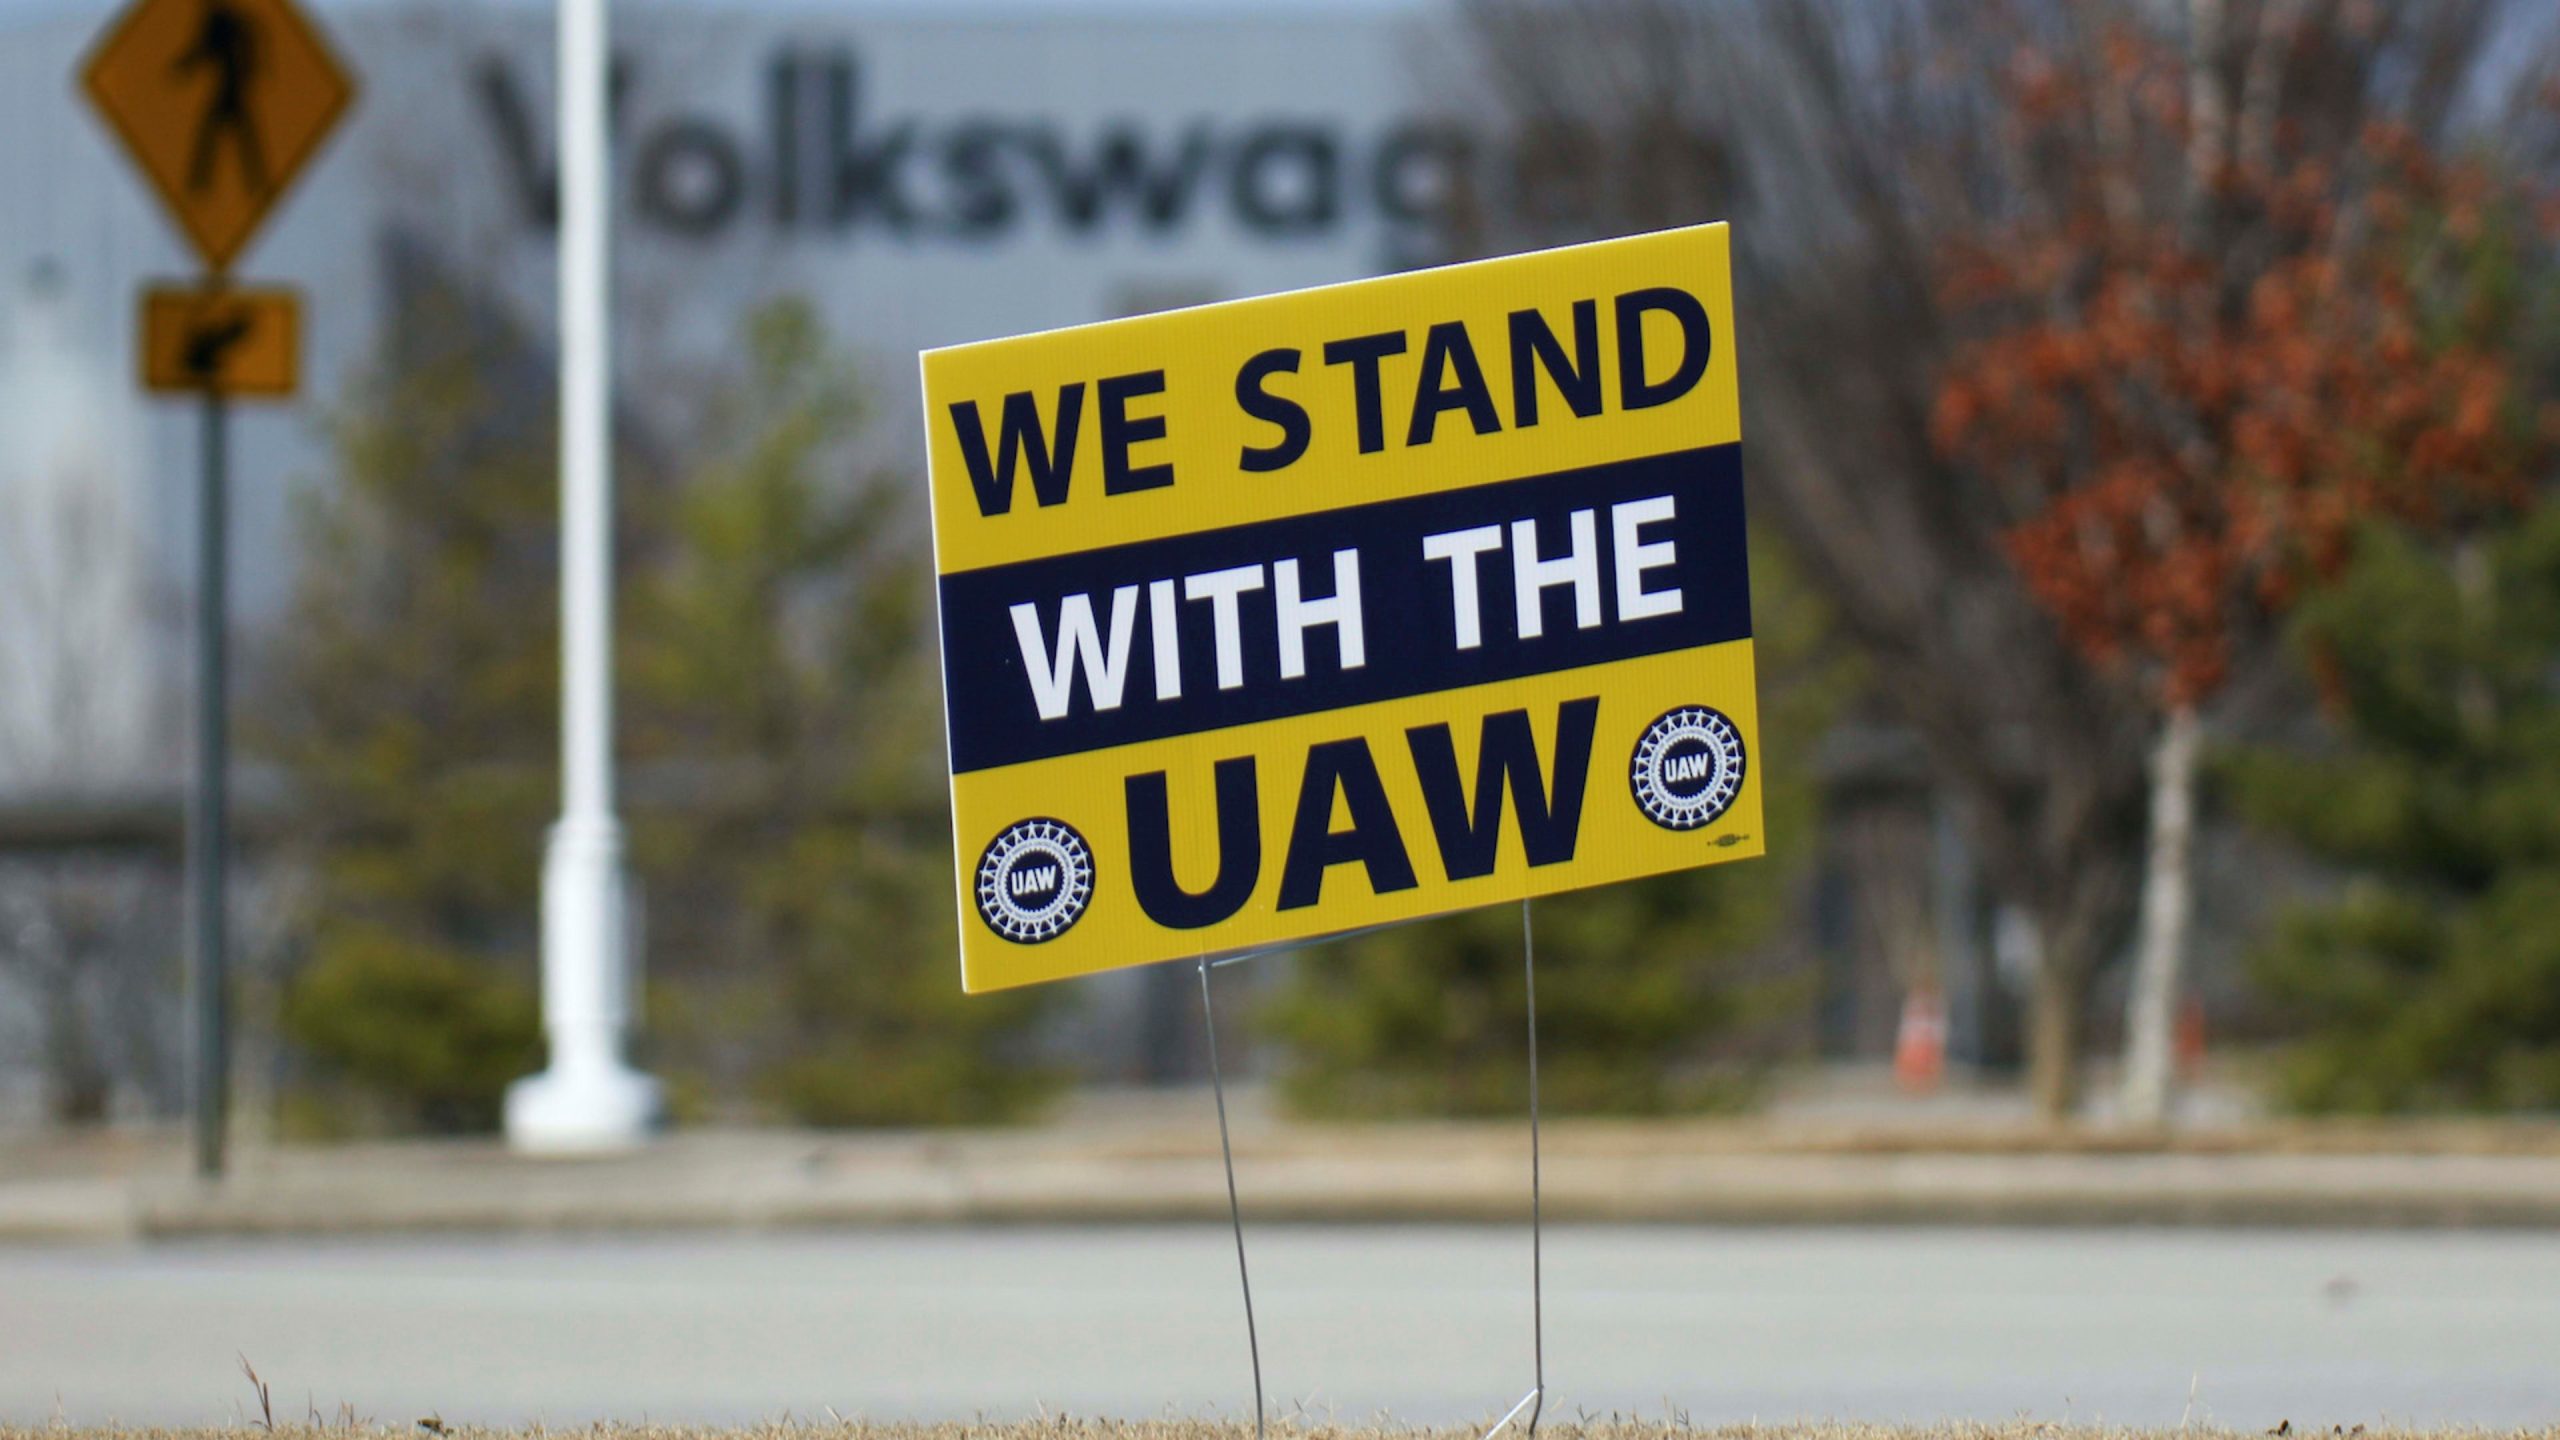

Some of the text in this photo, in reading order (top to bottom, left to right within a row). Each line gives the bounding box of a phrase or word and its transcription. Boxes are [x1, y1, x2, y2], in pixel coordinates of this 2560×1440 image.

[468, 42, 1742, 262] Volkswag
[948, 287, 1712, 518] WE STAND
[1009, 495, 1683, 721] WITH THE
[1124, 695, 1600, 931] UAW
[1664, 752, 1709, 783] UAW
[1010, 865, 1057, 896] UAW
